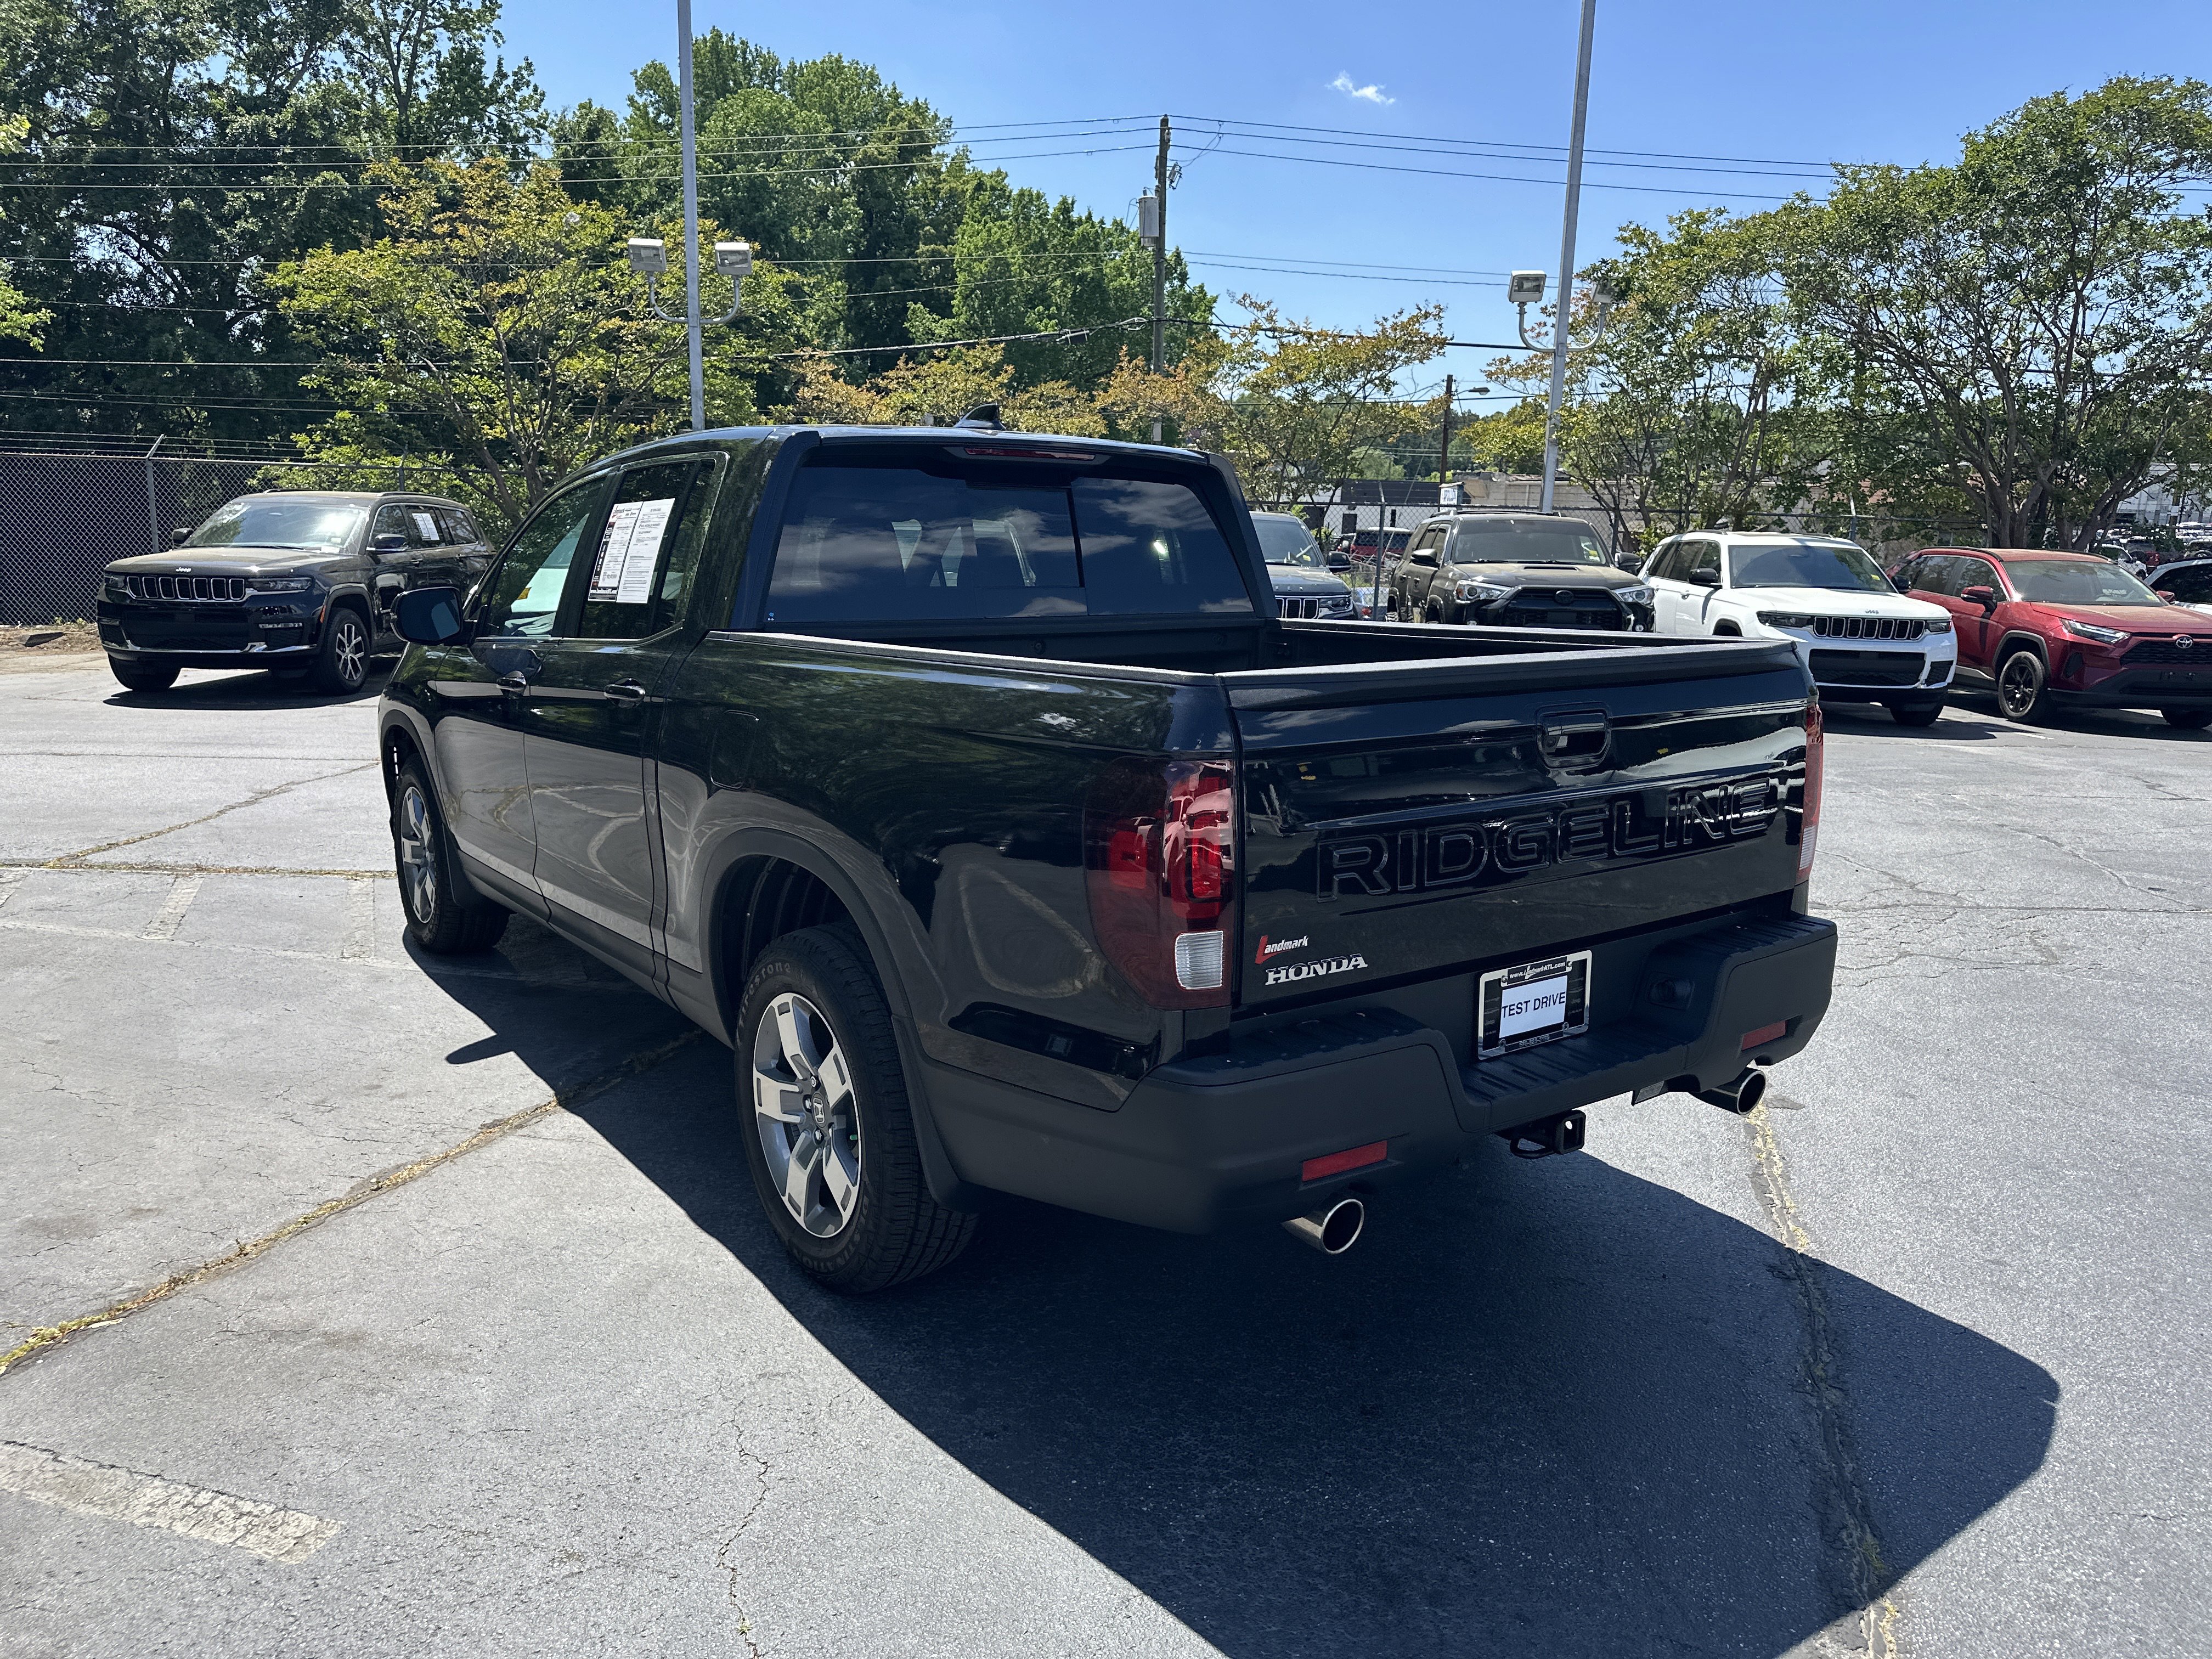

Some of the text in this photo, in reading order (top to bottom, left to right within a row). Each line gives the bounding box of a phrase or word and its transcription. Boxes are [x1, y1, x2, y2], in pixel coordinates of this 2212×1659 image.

[1316, 777, 1770, 903] RIDGELINE
[1255, 934, 1309, 965] Landmark
[1265, 953, 1368, 986] HONDA
[1502, 991, 1566, 1018] TEST DRIVE
